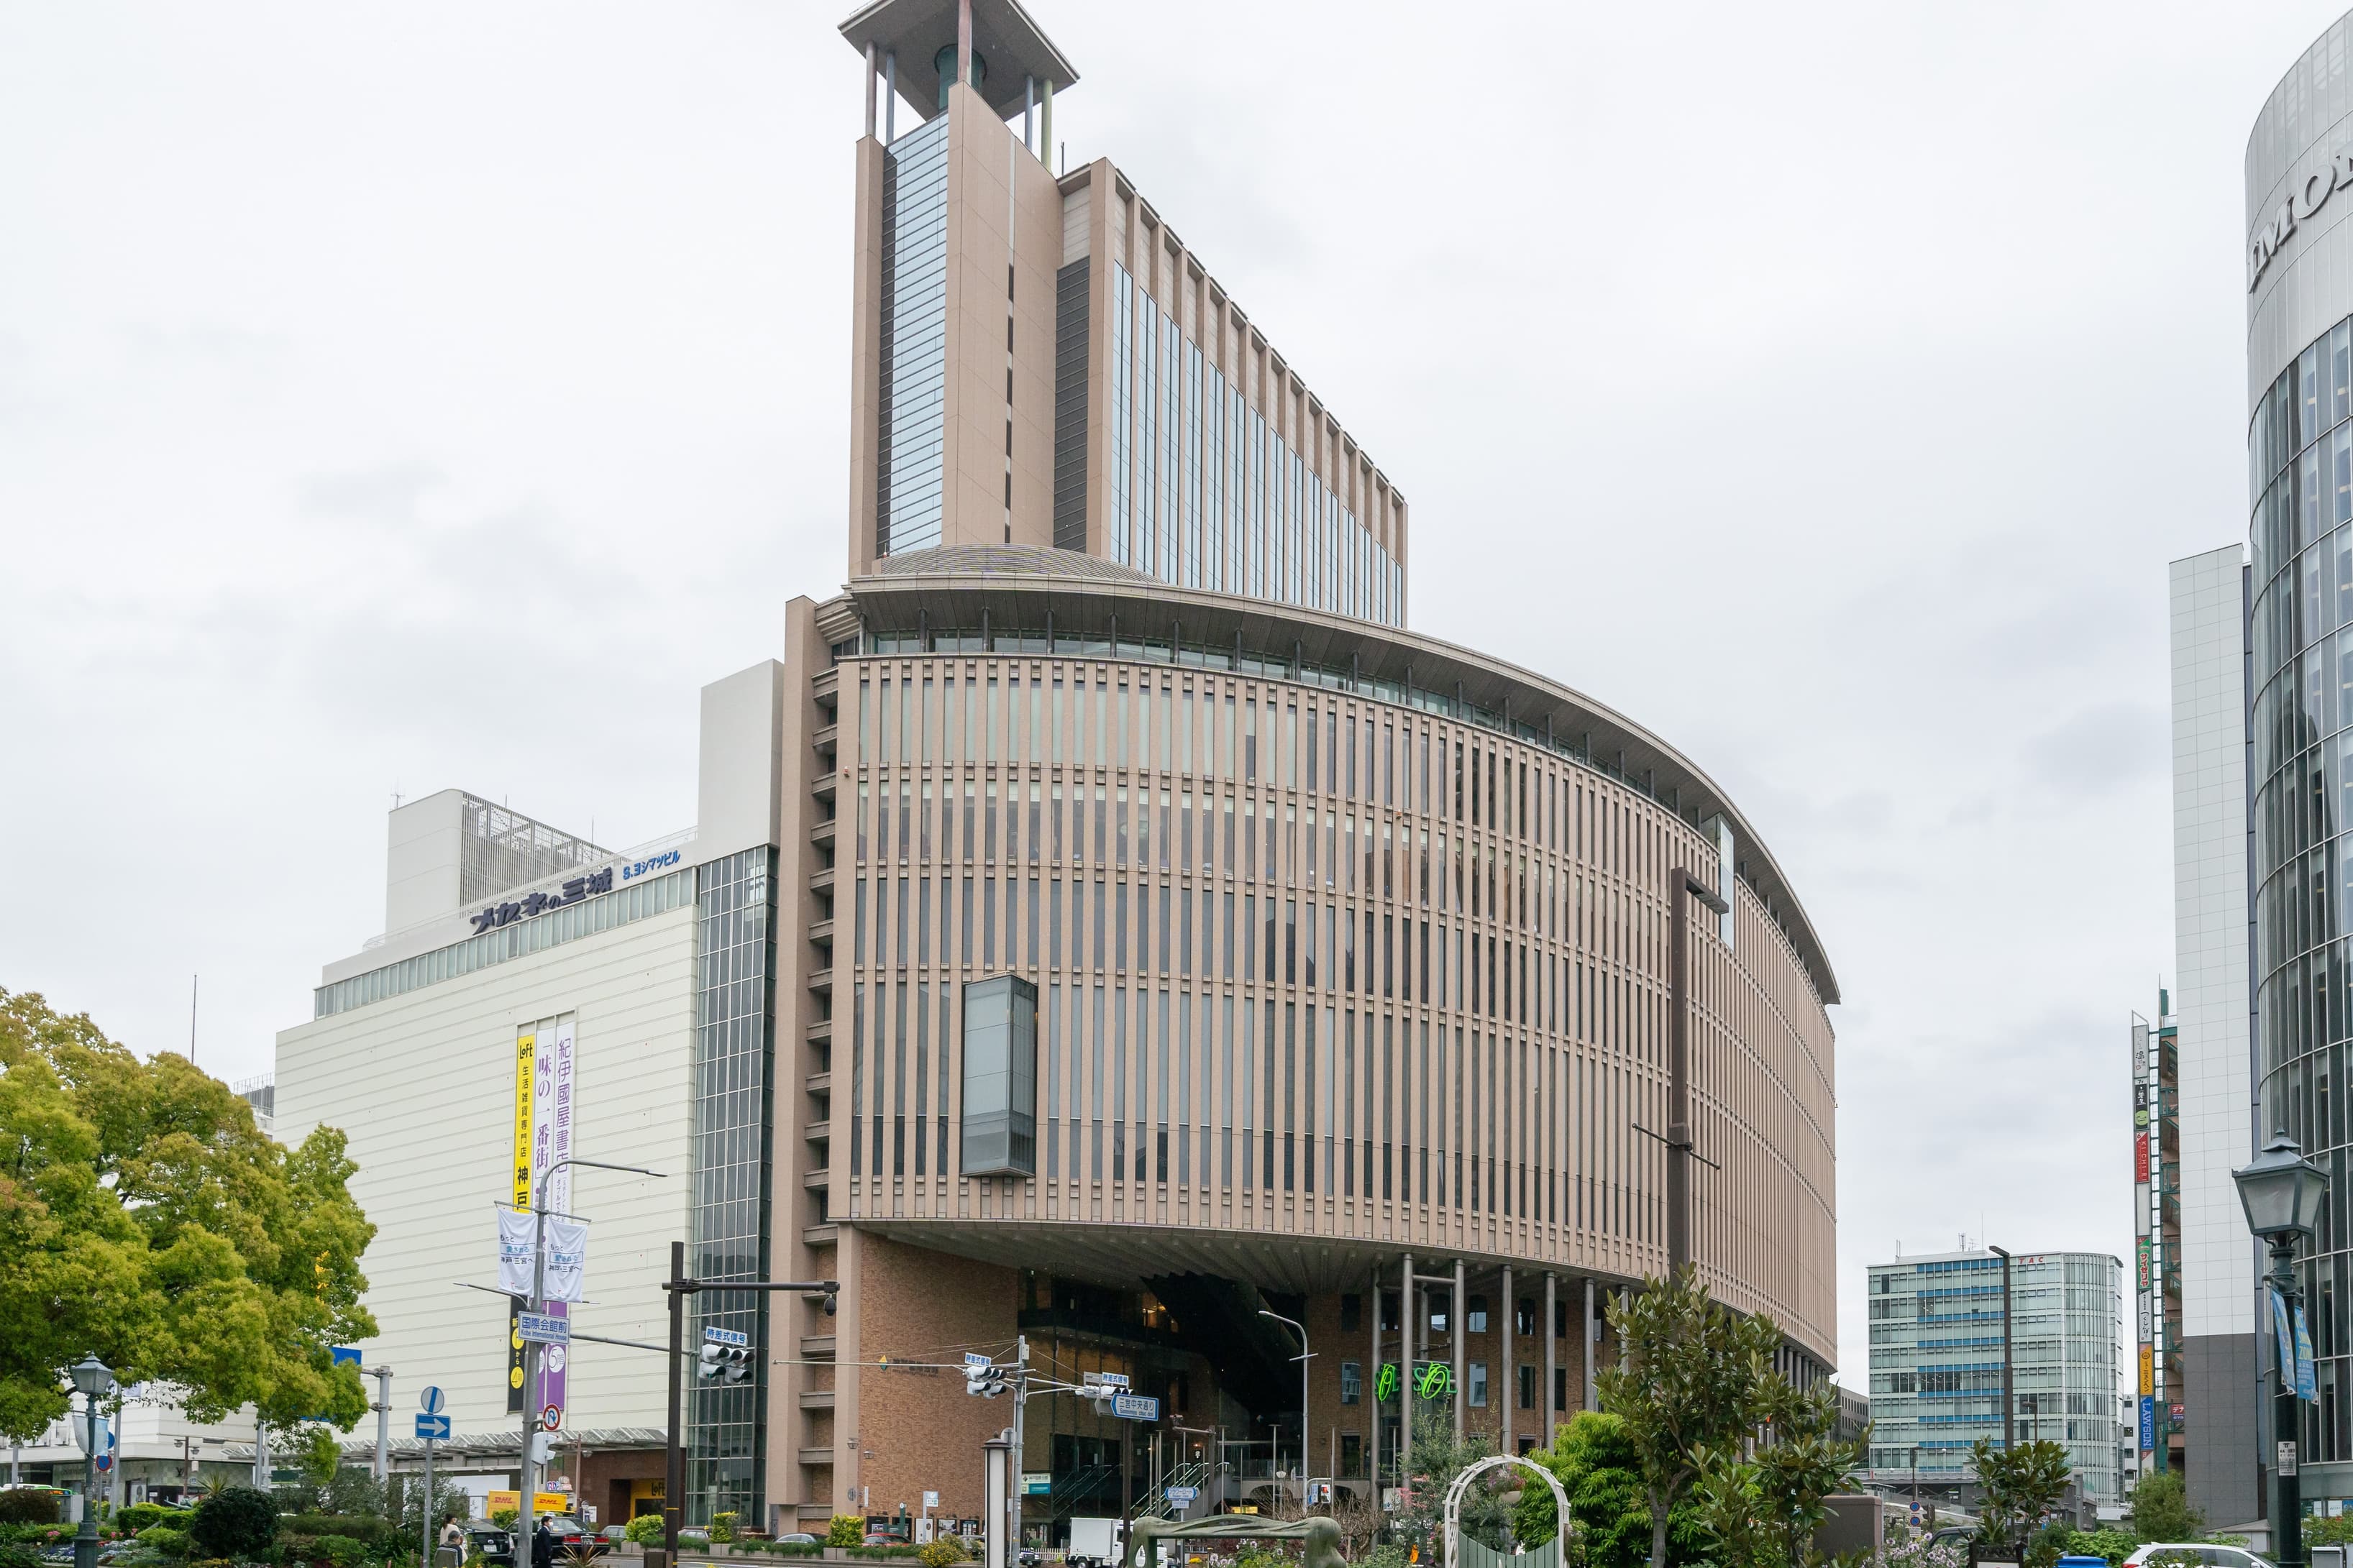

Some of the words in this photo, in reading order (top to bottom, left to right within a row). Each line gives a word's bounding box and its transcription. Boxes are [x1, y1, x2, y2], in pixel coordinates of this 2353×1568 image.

[2140, 1253, 2149, 1288] サイゼリヤ
[522, 1316, 567, 1334] 国際会館前
[707, 1328, 746, 1344] 時差式信号
[1103, 1373, 1128, 1384] 時差式信号
[1119, 1398, 1154, 1411] 三宮中央通り
[2143, 1403, 2152, 1446] LAWSON
